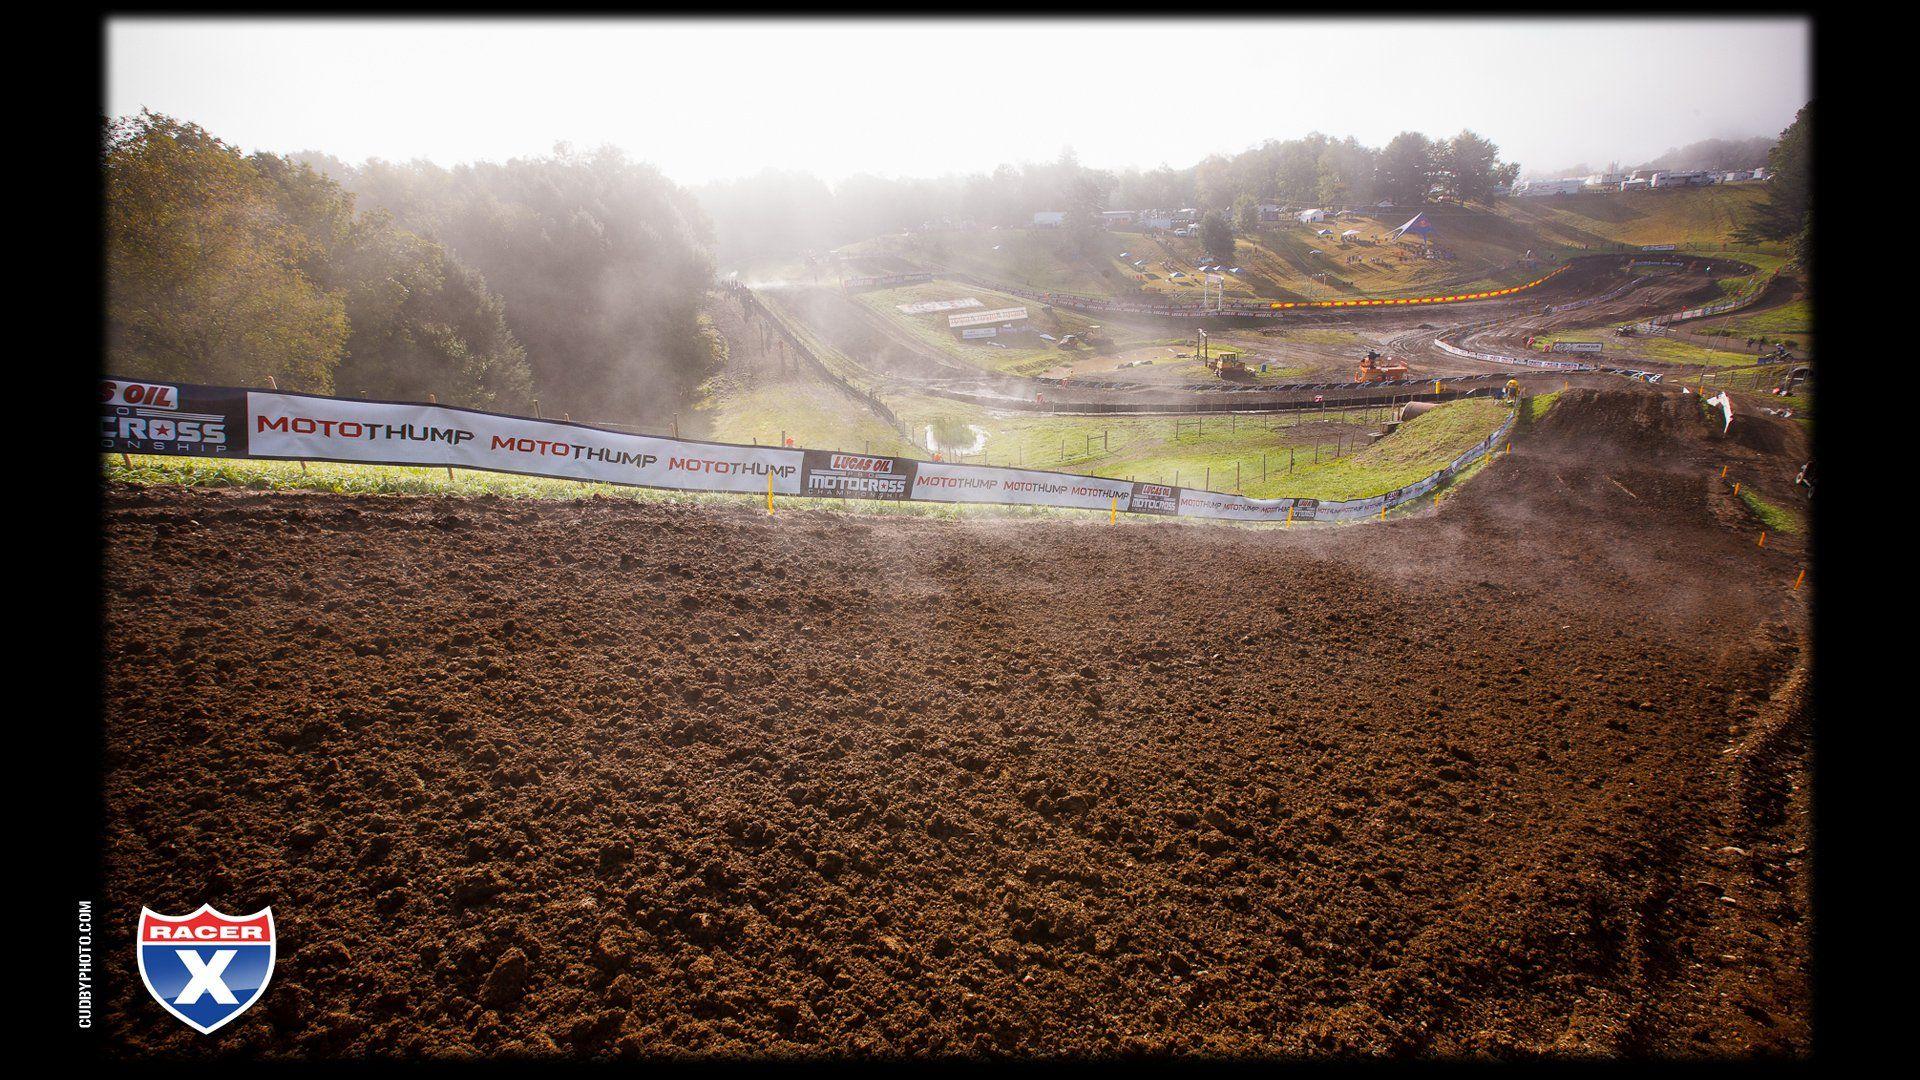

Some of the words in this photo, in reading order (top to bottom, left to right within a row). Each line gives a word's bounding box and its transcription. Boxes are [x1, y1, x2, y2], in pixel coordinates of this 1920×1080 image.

[123, 384, 171, 407] OIL
[257, 415, 475, 445] MOTOTHUMP
[490, 435, 658, 468] MOTOTHUMP
[669, 457, 797, 479] MOTOTHUMP
[833, 456, 873, 470] LUCAS
[873, 459, 890, 472] OIL
[808, 474, 906, 493] MOTOCROSS
[917, 476, 998, 489] MOTOTHUMP
[1003, 481, 1068, 494] MOTOTHUMP
[1071, 486, 1130, 499] MOTOTHUMP
[1131, 499, 1176, 510] MOTOCROSS
